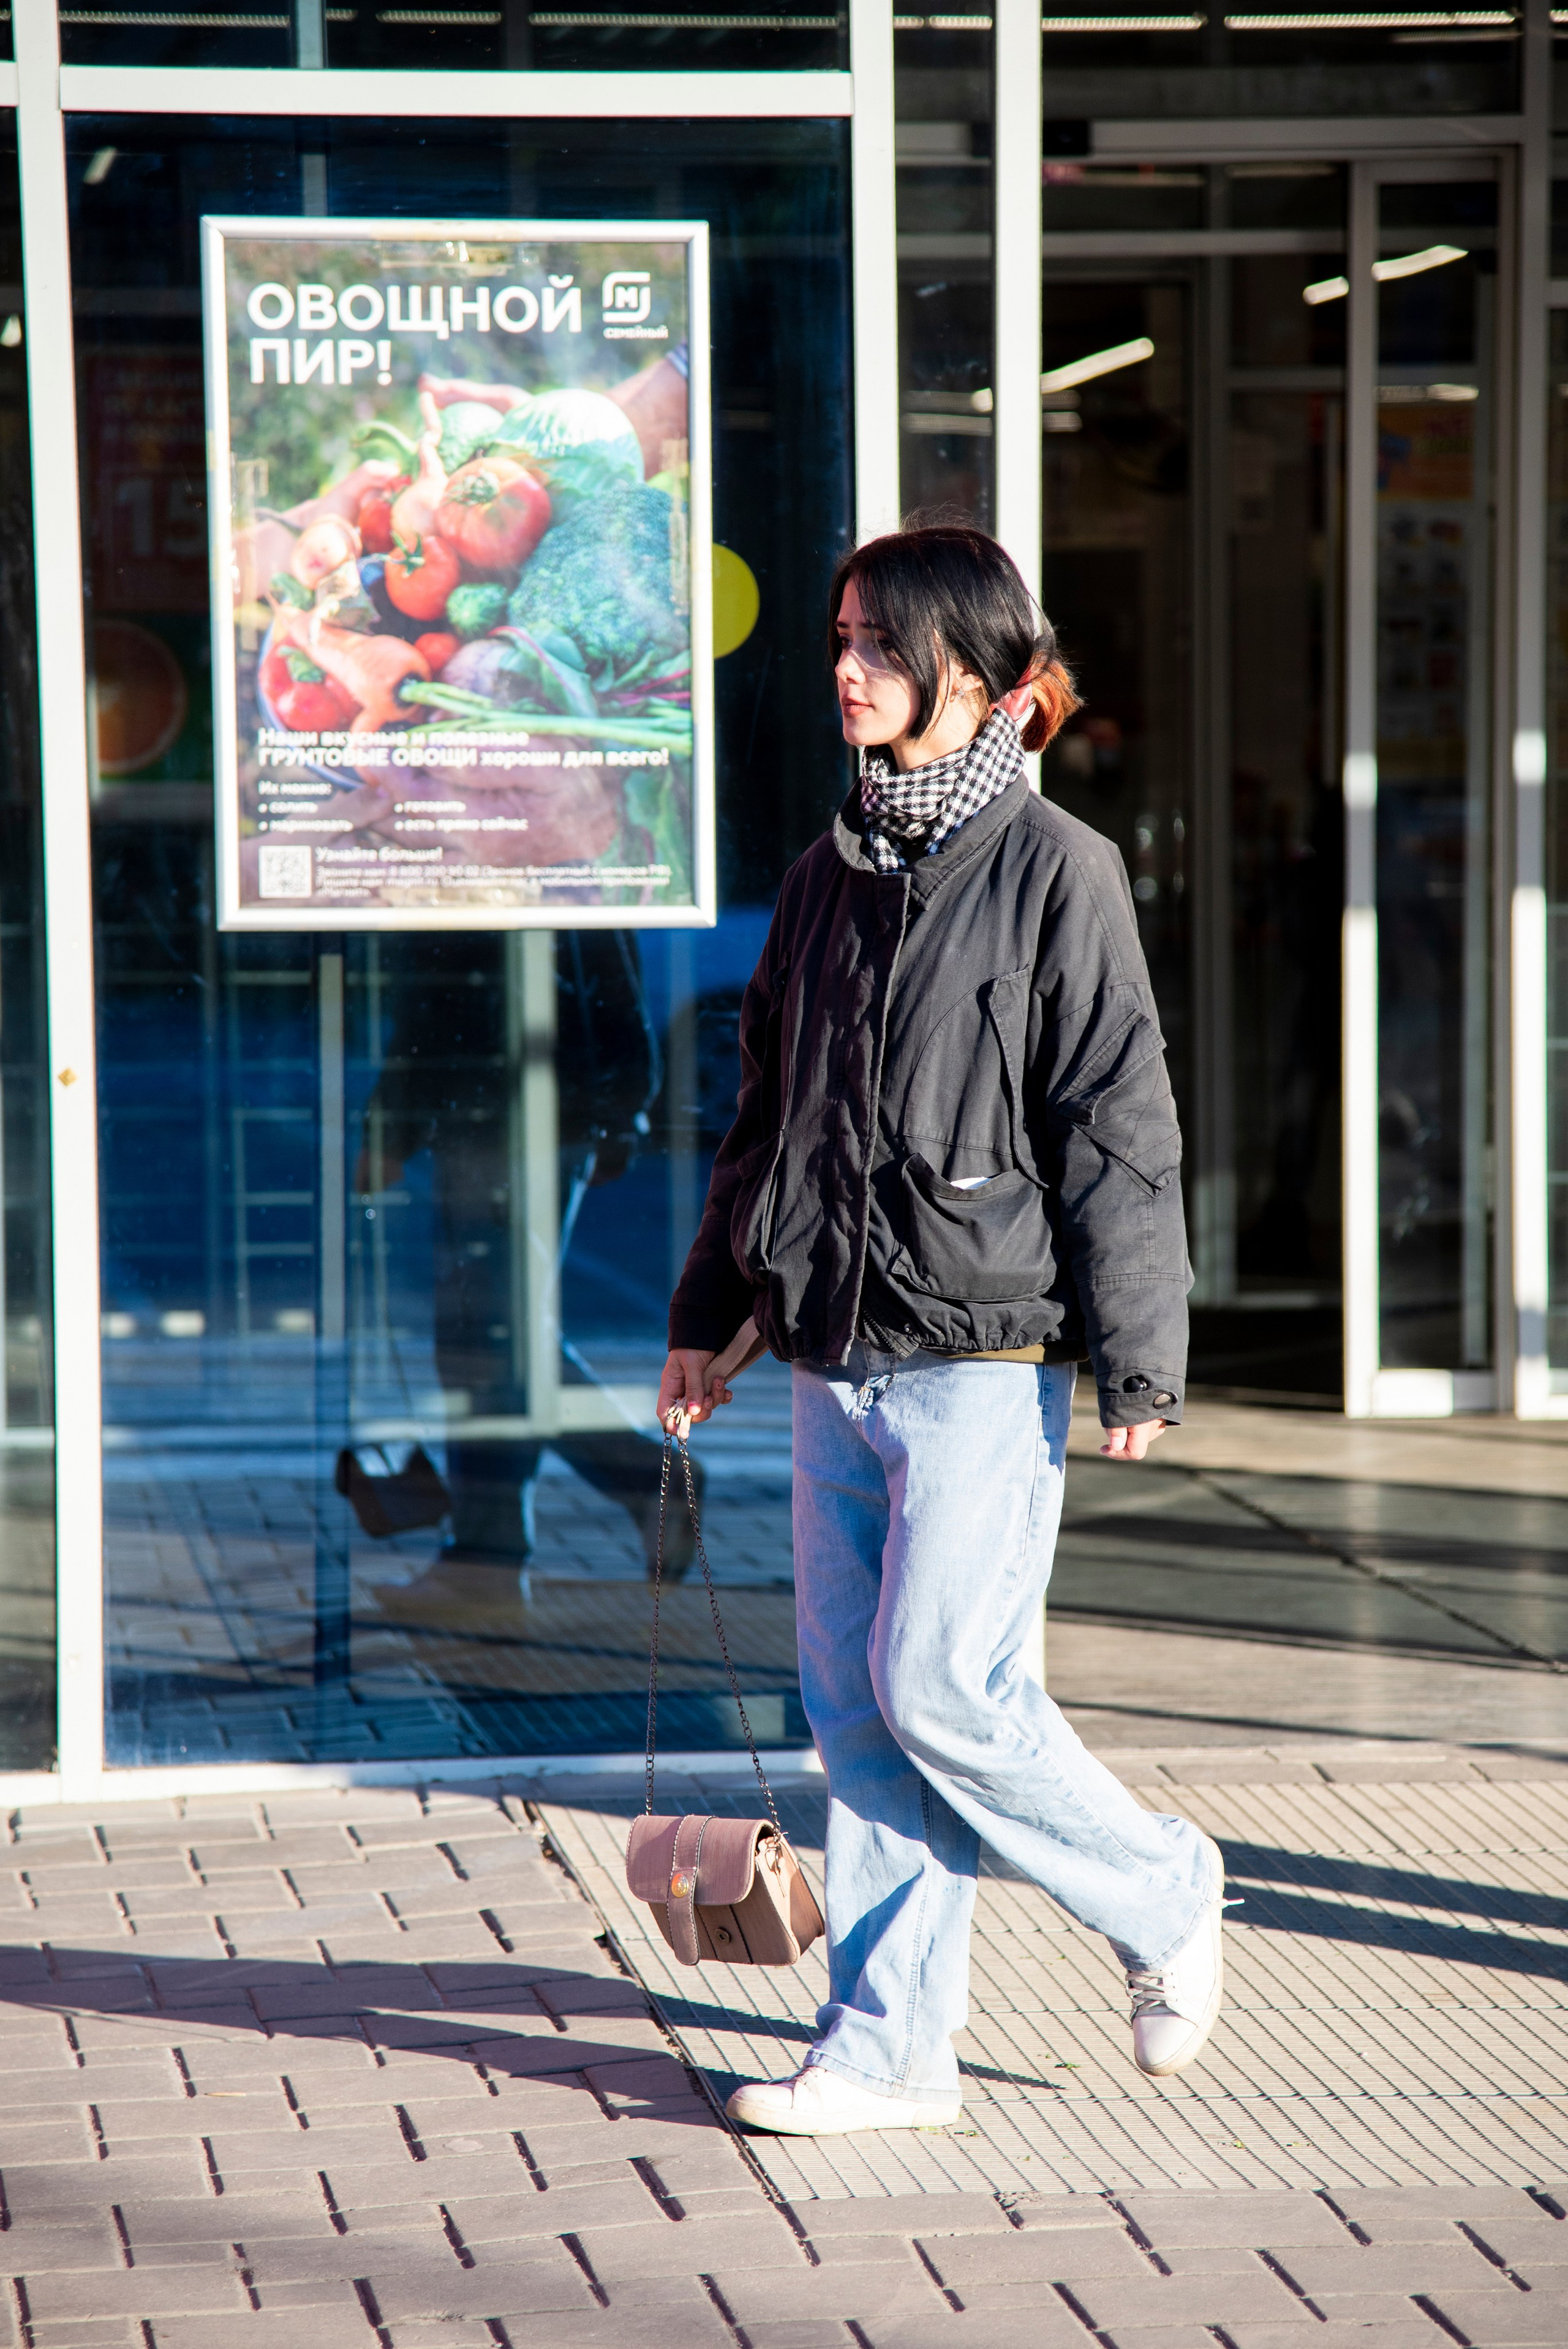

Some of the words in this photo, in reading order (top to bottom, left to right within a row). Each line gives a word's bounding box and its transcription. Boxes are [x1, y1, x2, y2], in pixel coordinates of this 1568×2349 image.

[247, 274, 582, 340] ОВОЩНОЙ
[603, 325, 669, 339] СЕМЕЙНЫЙ
[250, 337, 392, 386] ПИР!
[258, 728, 318, 746] Наши
[321, 731, 408, 748] вкусные
[410, 731, 425, 746] и
[428, 731, 529, 747] полезные
[258, 747, 390, 767] ГРУНТОВЫЕ
[391, 747, 477, 769] ОВОЩИ
[480, 751, 560, 770] хороши
[562, 751, 603, 769] для
[605, 747, 669, 767] всего!
[258, 780, 279, 795] Их
[280, 783, 331, 795] можно:
[269, 801, 318, 813] солить
[404, 801, 466, 813] готовить
[480, 816, 528, 831] сейчас
[315, 846, 378, 862] Узнайте
[378, 846, 442, 862] больше!
